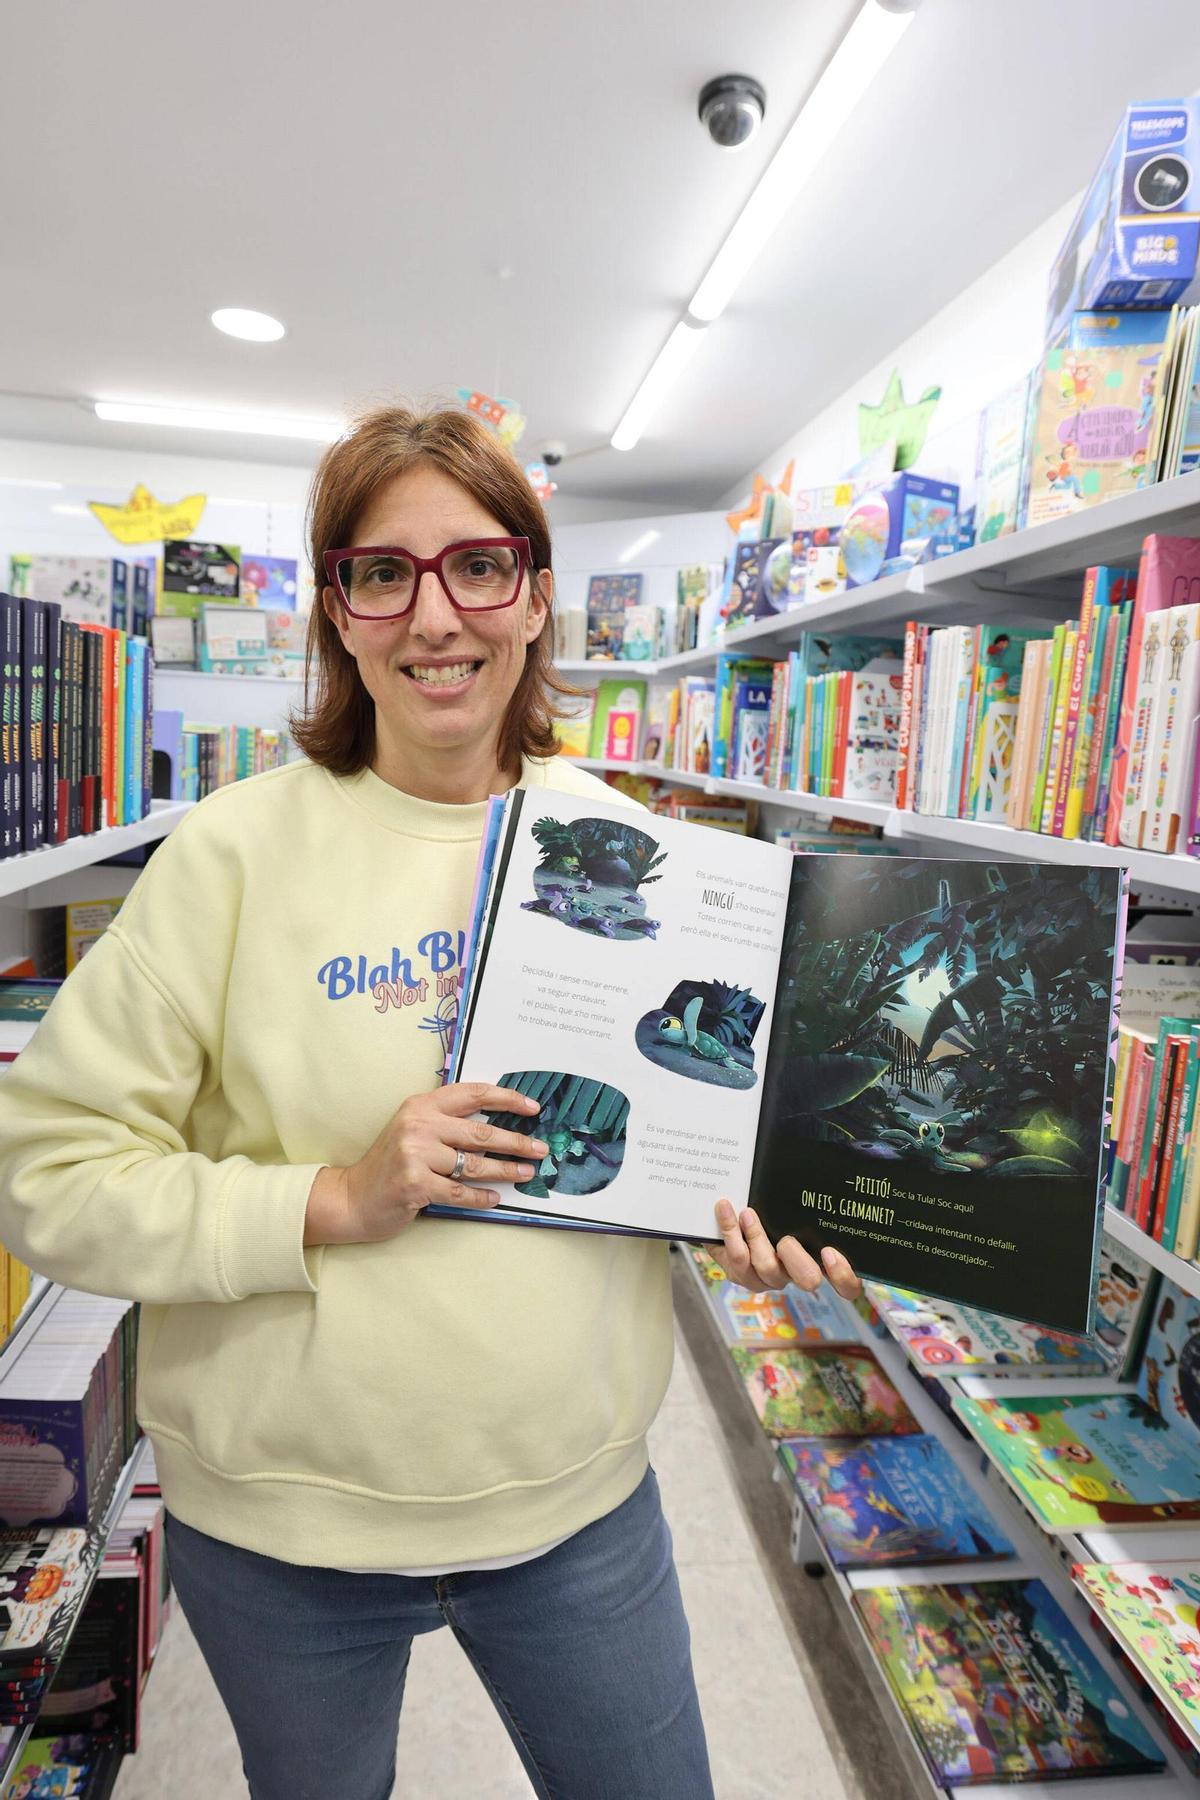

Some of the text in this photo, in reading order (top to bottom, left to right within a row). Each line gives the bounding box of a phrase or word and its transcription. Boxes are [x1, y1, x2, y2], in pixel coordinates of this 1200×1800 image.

[1131, 117, 1185, 130] TELESCOPE
[702, 889, 735, 910] NINGÚ
[317, 930, 465, 1000] Blah Bl
[373, 976, 429, 1014] Not
[892, 1188, 907, 1199] Soc
[908, 1192, 915, 1200] la
[917, 1193, 936, 1205] Tula!
[937, 1198, 952, 1209] Soc
[801, 1190, 816, 1208] ON
[818, 1194, 836, 1215] ETS,
[839, 1198, 895, 1226] GERMANET?
[935, 1225, 972, 1242] intentant
[974, 1235, 986, 1244] no
[987, 1237, 1019, 1252] defallir.
[818, 1218, 838, 1230] Tenia
[839, 1224, 867, 1237] poques
[868, 1232, 914, 1249] esperances.
[917, 1242, 930, 1252] Era
[983, 1619, 1051, 1713] POBLES
